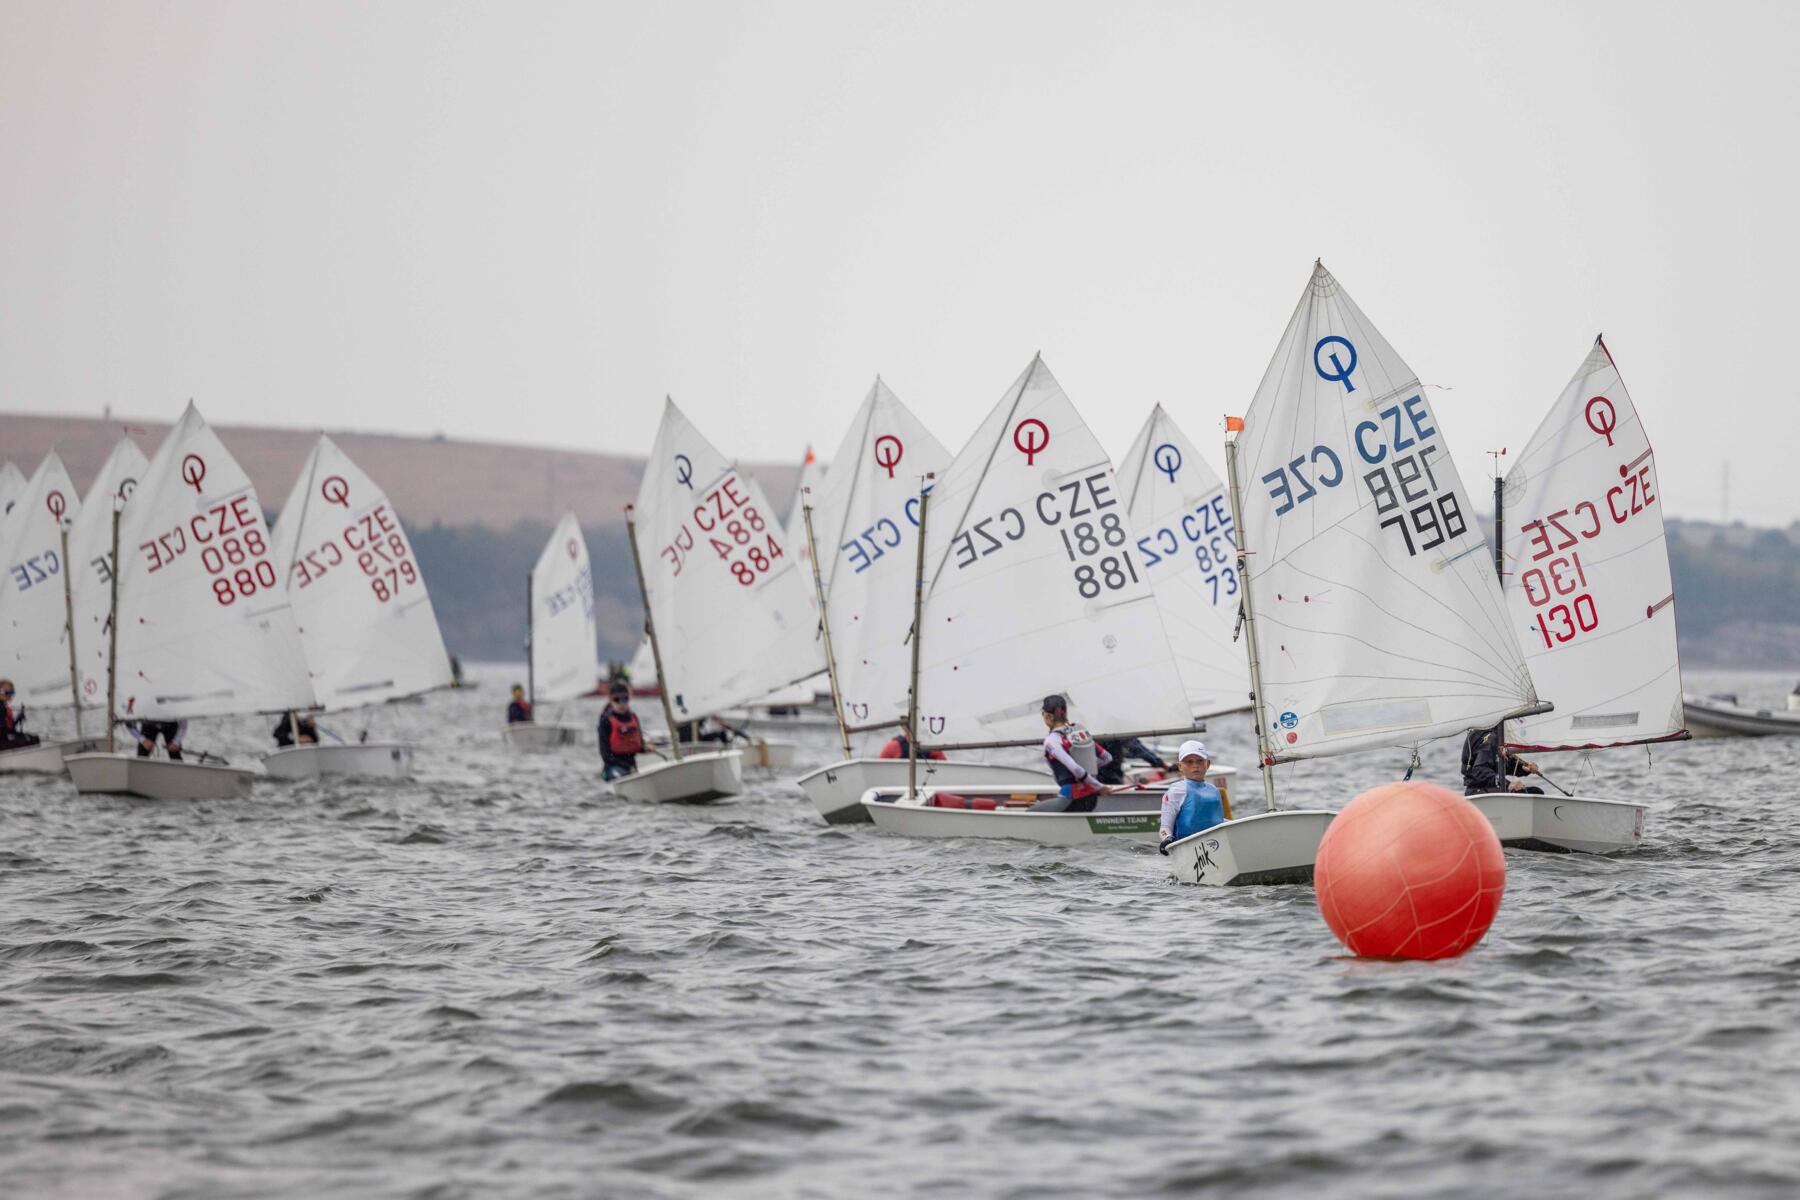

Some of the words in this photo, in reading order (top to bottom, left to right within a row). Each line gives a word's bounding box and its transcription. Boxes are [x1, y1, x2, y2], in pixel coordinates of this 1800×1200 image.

[1354, 394, 1436, 465] CZE
[693, 477, 750, 532] CZE
[1035, 472, 1117, 526] CZE
[1182, 495, 1231, 541] CZE
[1606, 465, 1655, 524] CZE
[191, 496, 256, 543] CZE
[343, 506, 395, 551] CZE
[1380, 491, 1467, 556] 798
[213, 561, 275, 605] 880
[371, 560, 416, 602] 879
[730, 534, 784, 586] 884
[1074, 550, 1139, 599] 881
[1205, 568, 1237, 606] 73
[1536, 593, 1599, 649] 130
[1096, 817, 1125, 825] WINNER
[1126, 816, 1148, 824] TEAM
